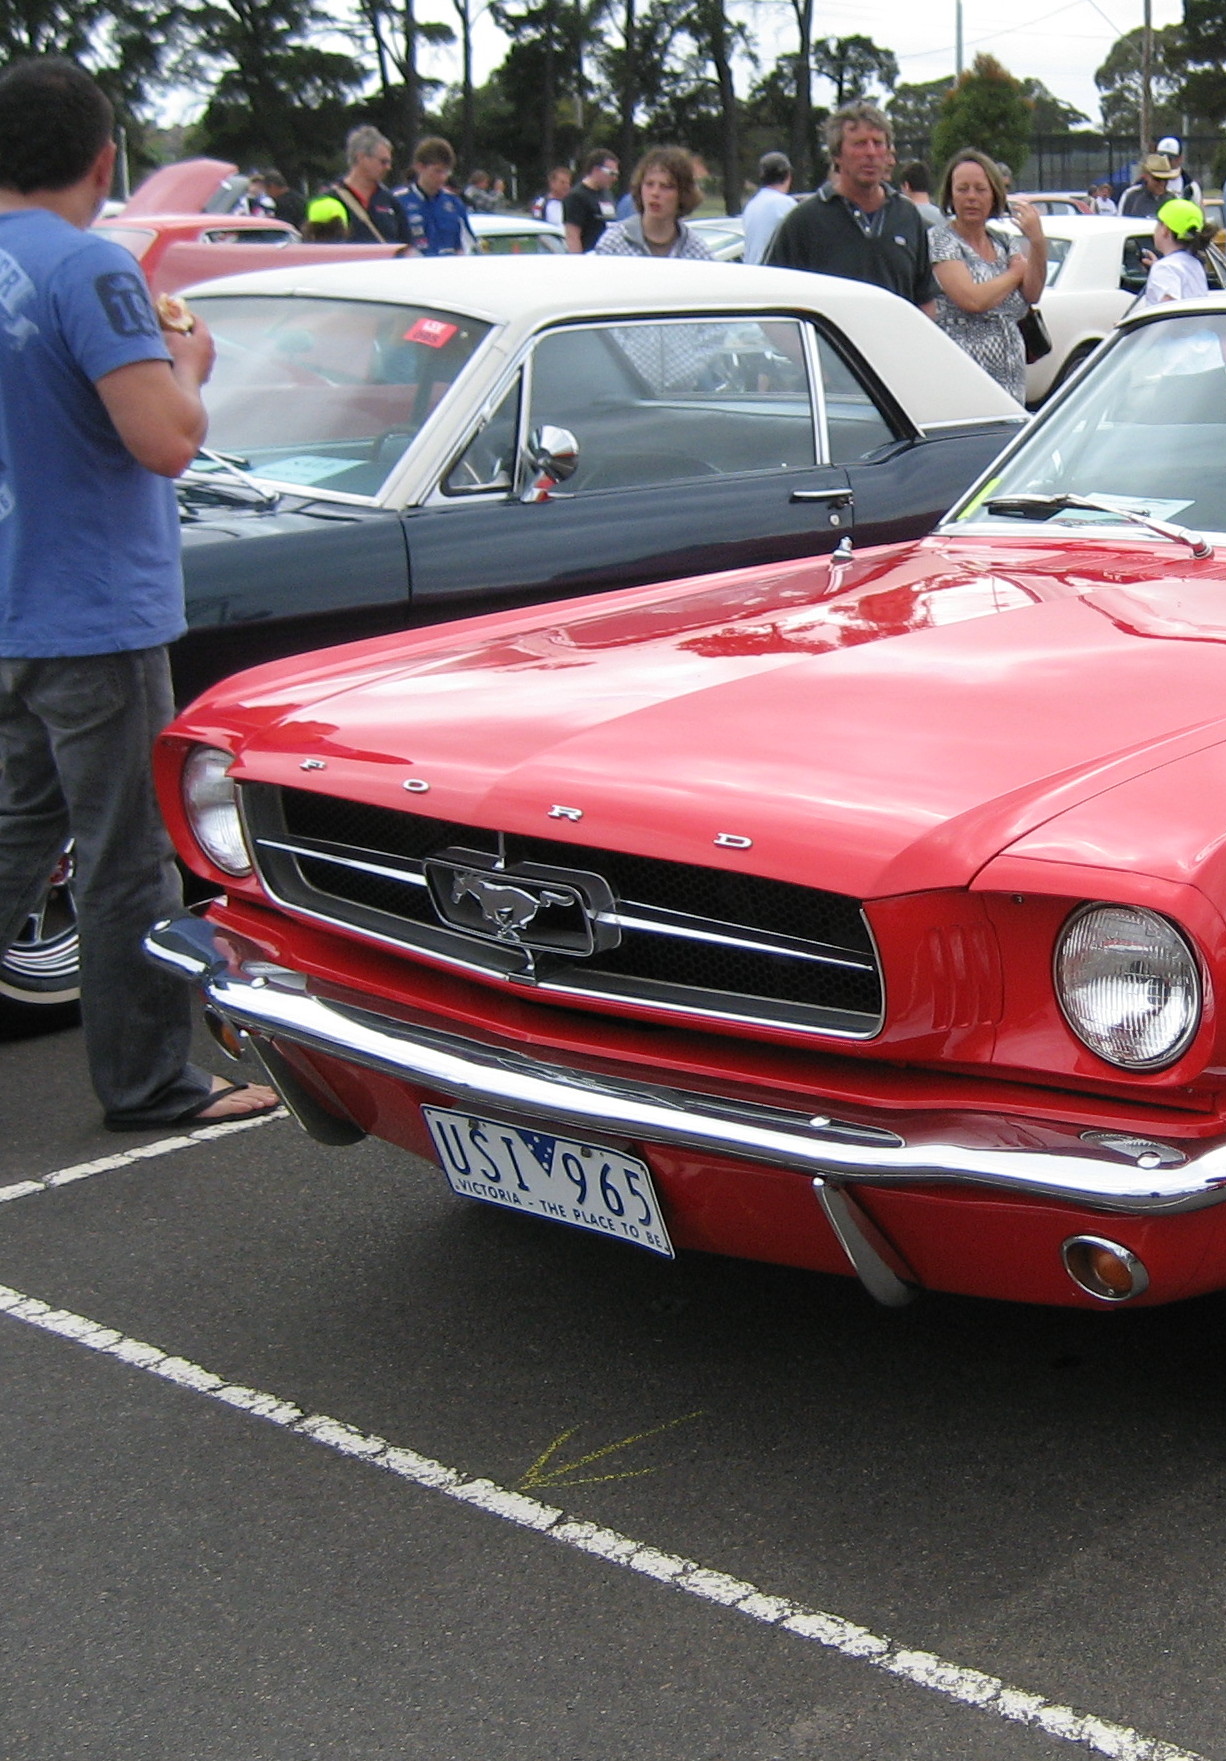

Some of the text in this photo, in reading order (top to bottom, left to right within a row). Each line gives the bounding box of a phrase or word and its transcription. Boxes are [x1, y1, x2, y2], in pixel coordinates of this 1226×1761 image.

[436, 1120, 651, 1227] USI 965
[458, 1178, 522, 1206] VICTORIA
[539, 1199, 567, 1218] THE
[573, 1207, 617, 1232] PLACE
[621, 1220, 640, 1239] TO
[646, 1231, 662, 1249] BE
